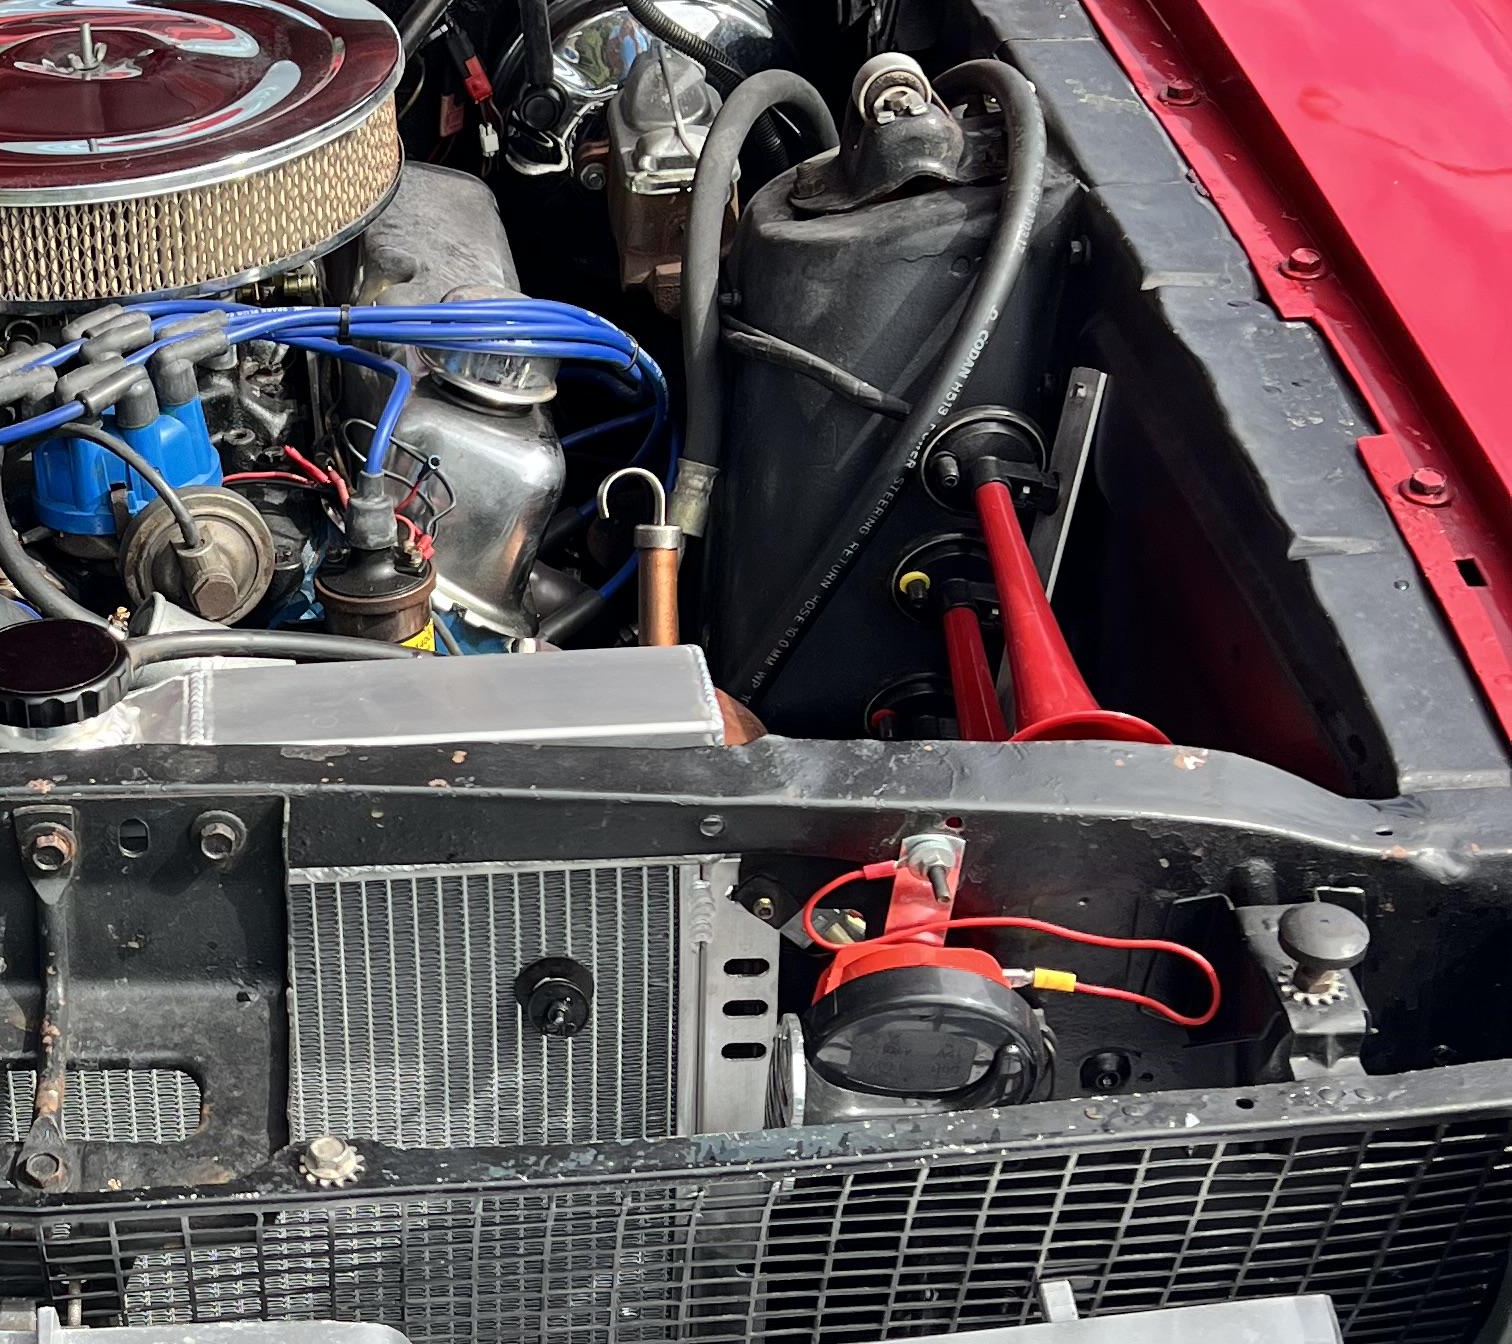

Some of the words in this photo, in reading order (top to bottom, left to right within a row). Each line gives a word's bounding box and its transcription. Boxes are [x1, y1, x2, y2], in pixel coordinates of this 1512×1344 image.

[958, 329, 989, 379] CODAN
[858, 477, 904, 535] STEERING
[820, 541, 860, 589] RETURN
[794, 594, 822, 623] HOSE
